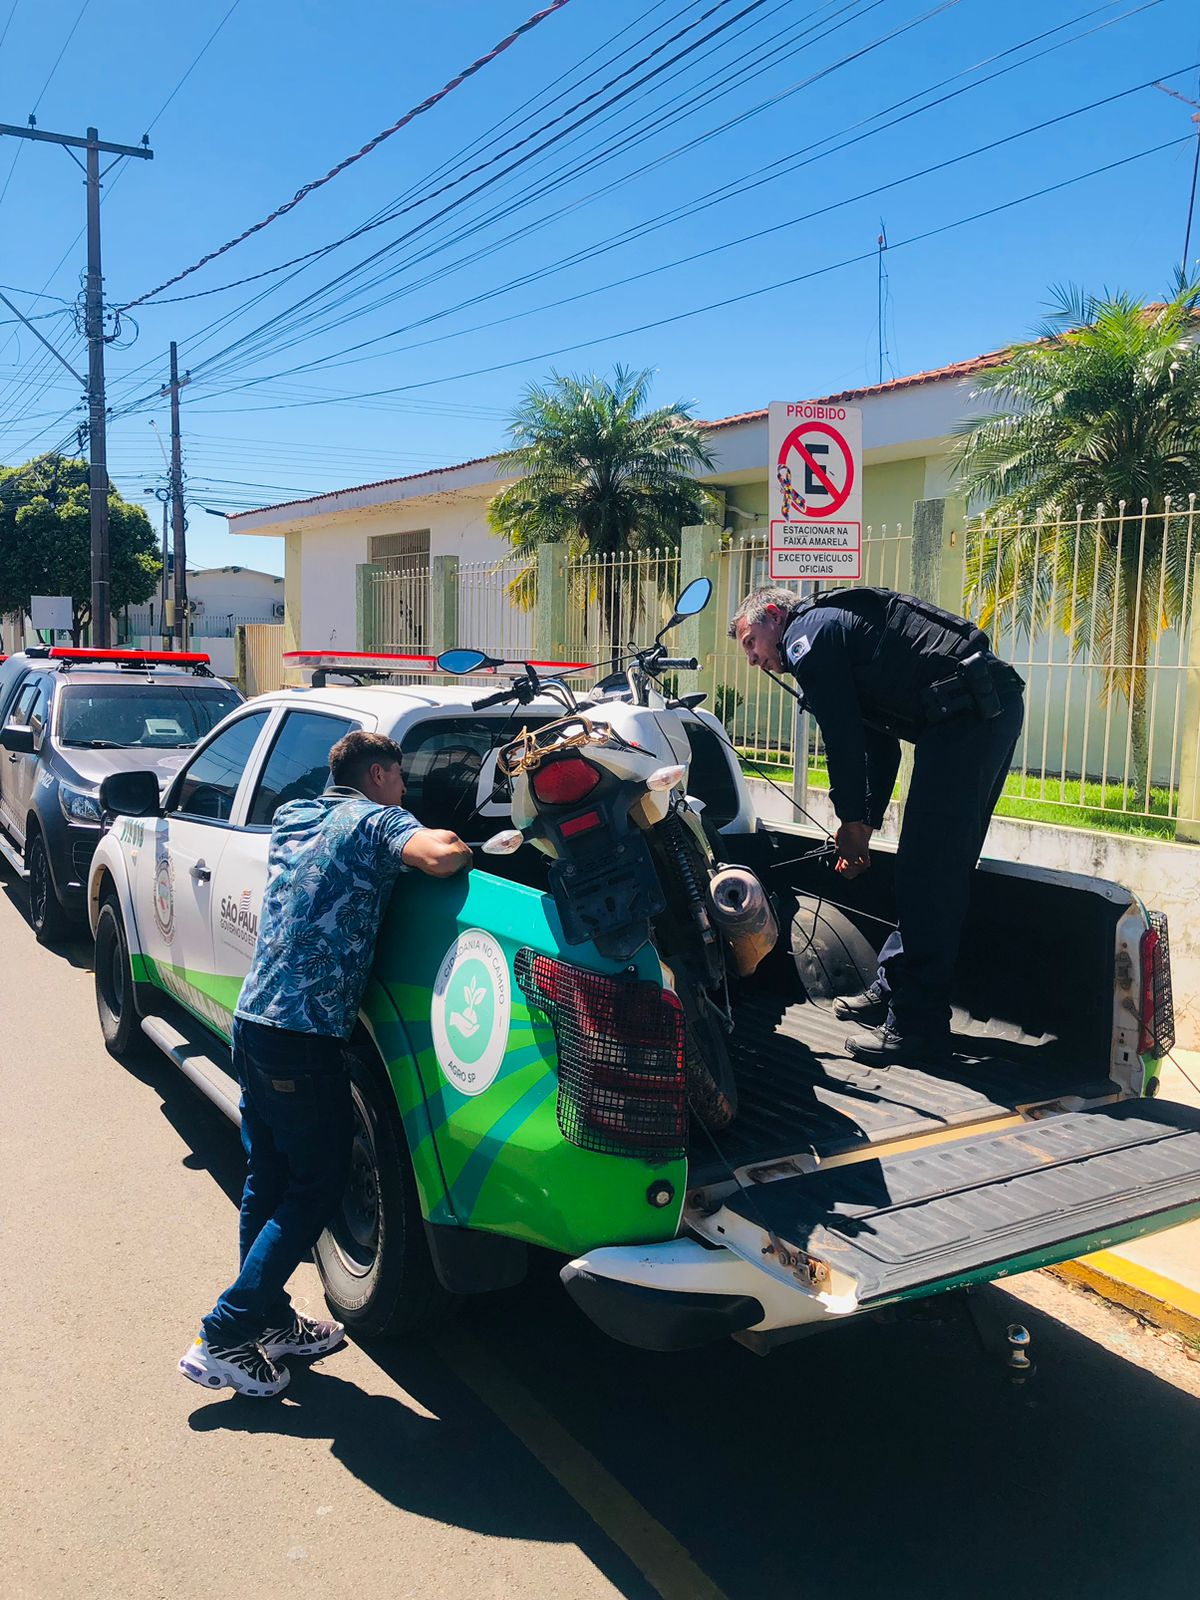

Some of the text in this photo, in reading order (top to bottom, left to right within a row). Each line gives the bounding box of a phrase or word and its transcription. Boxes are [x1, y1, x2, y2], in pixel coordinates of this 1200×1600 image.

[786, 404, 847, 421] PROIBIDO
[804, 443, 829, 495] E
[783, 525, 849, 536] ESTACIONAR NA
[783, 536, 848, 547] FAIXA AMARELA
[778, 552, 853, 563] EXCETO VEÍCULOS
[798, 565, 834, 574] OFICIAIS
[220, 895, 258, 937] SÃO PAUL
[443, 939, 505, 1005] CIDADANIA NO CAMPO
[447, 1060, 476, 1084] AGRO SP
